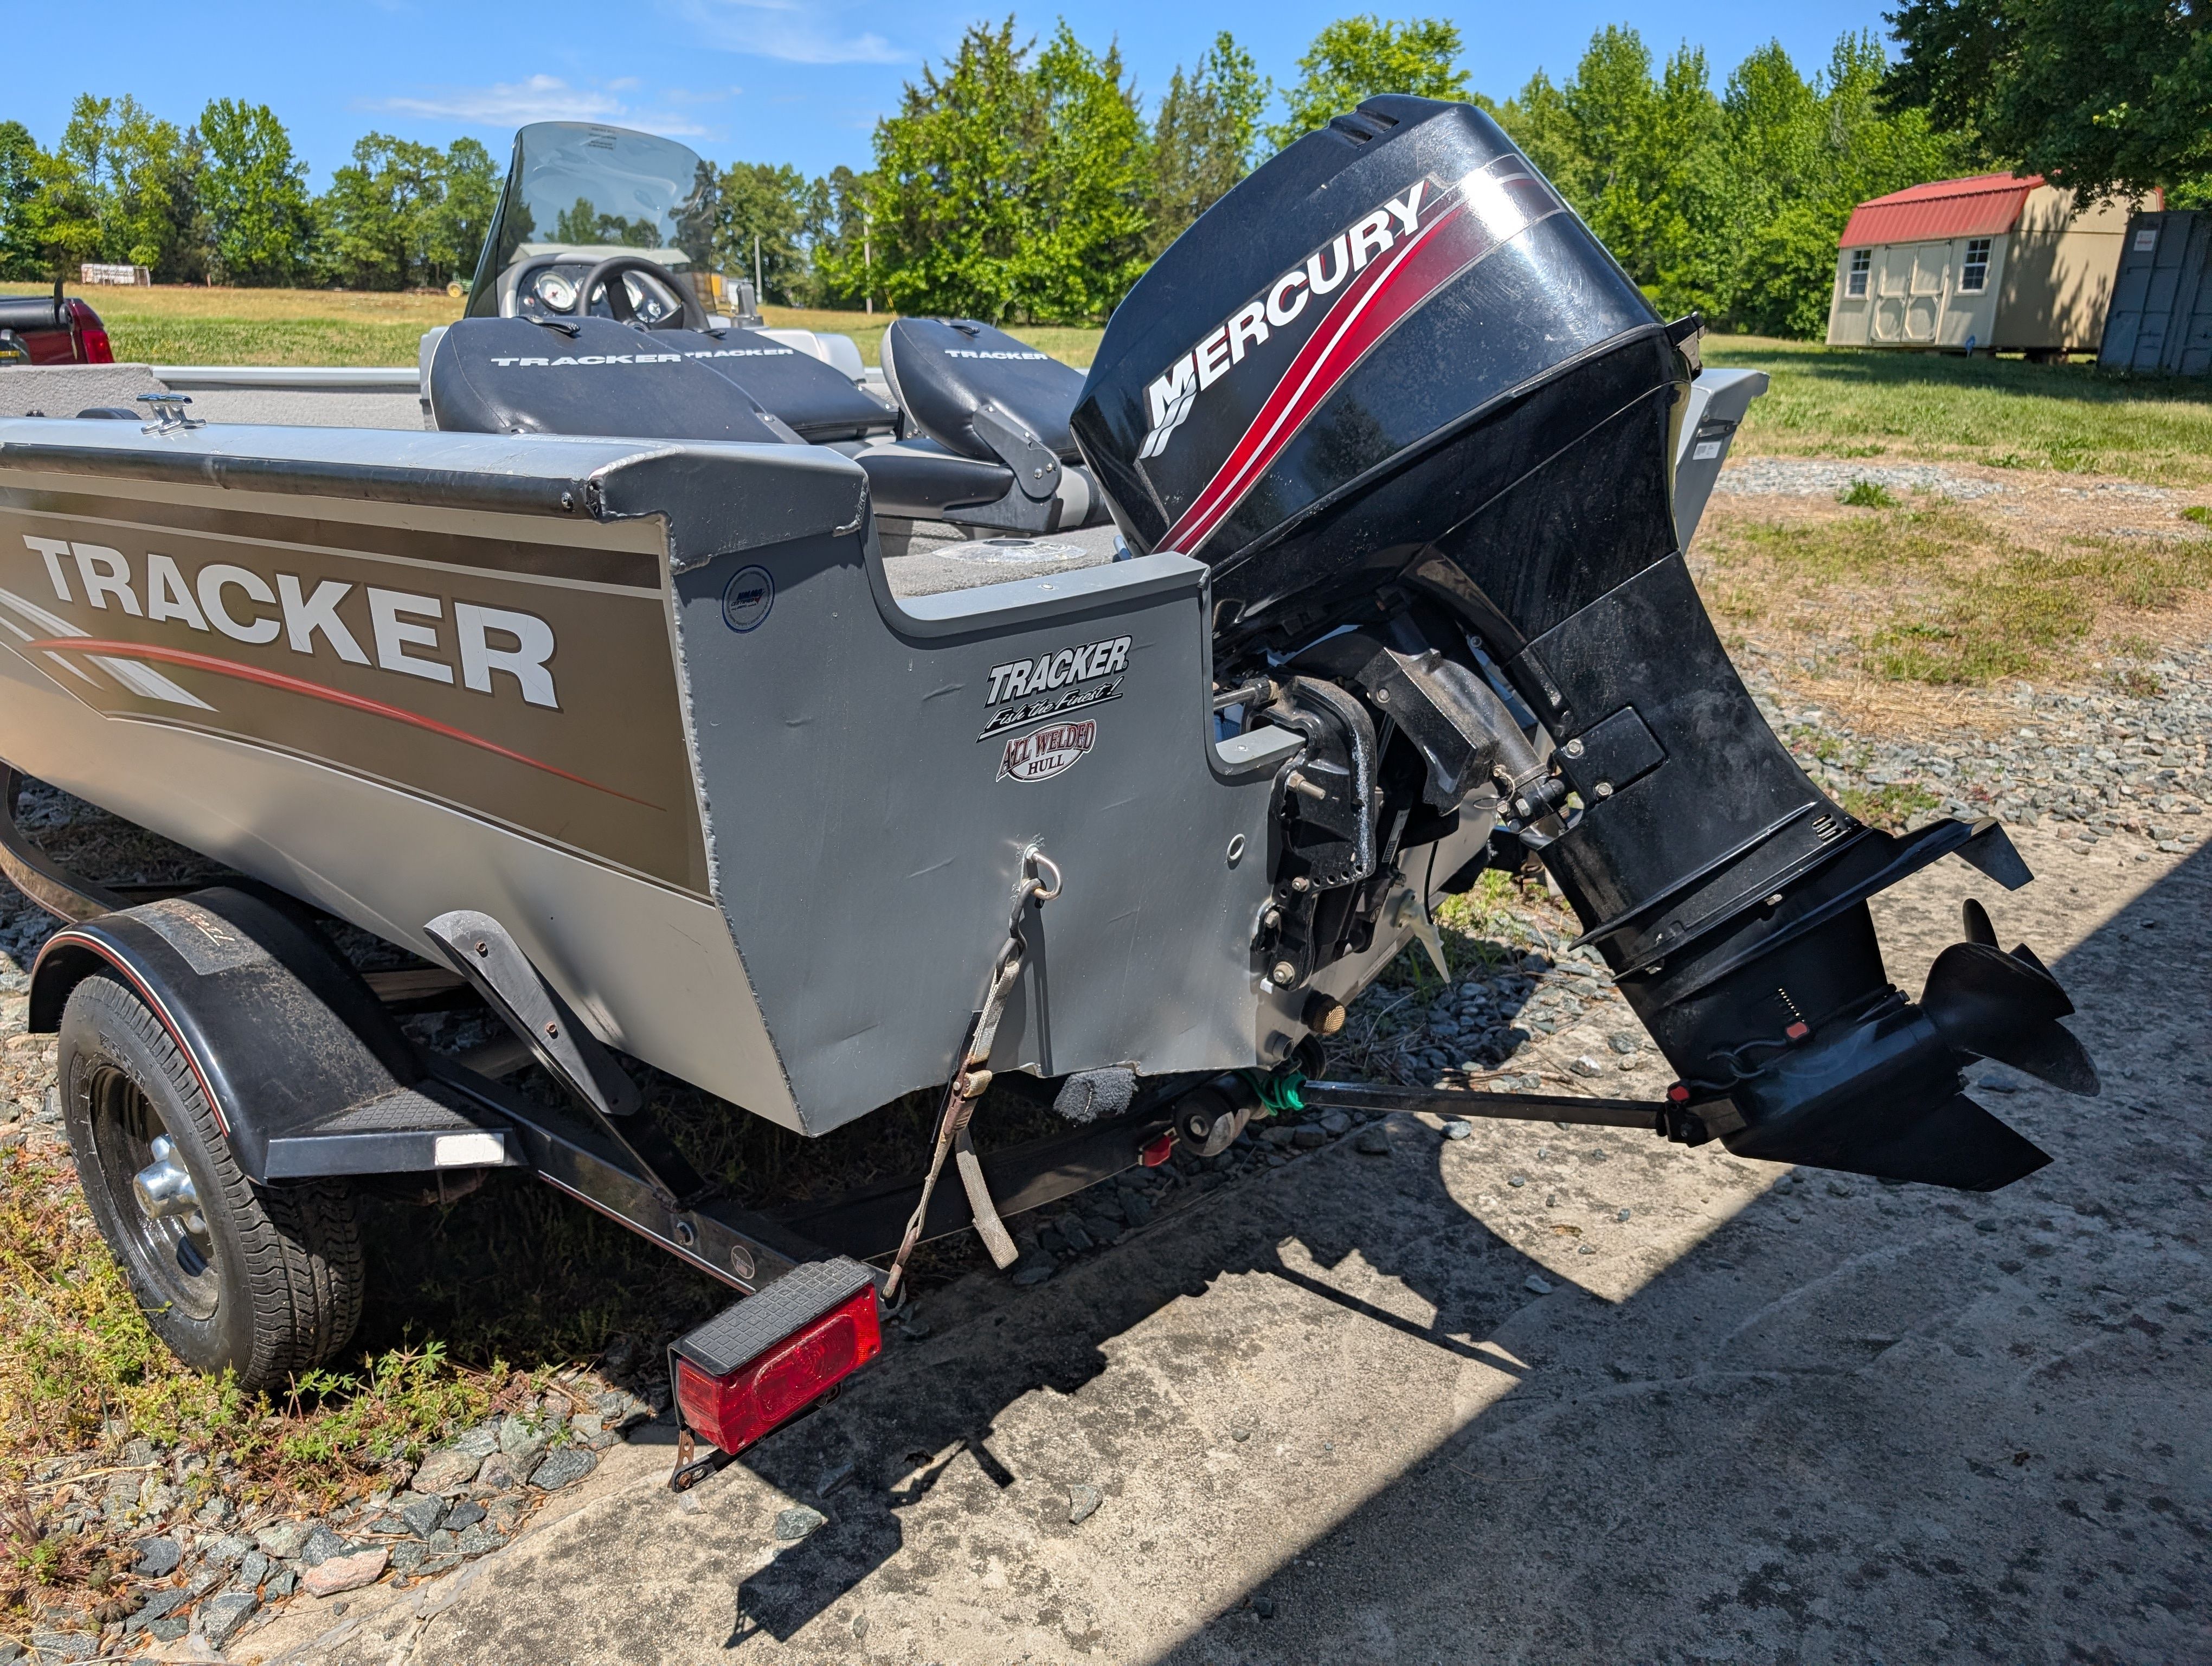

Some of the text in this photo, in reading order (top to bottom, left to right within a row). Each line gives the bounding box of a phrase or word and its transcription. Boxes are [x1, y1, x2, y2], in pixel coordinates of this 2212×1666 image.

[1140, 181, 1431, 458] MERCURY
[491, 354, 681, 367] TRACKER
[944, 349, 1049, 360] TRACKER
[23, 535, 559, 709] TRACKER
[987, 636, 1132, 705] TRACKER
[988, 704, 1026, 728] Fish
[1030, 699, 1053, 717] the
[999, 722, 1095, 776] ALL WELDED
[1027, 755, 1065, 776] HULL
